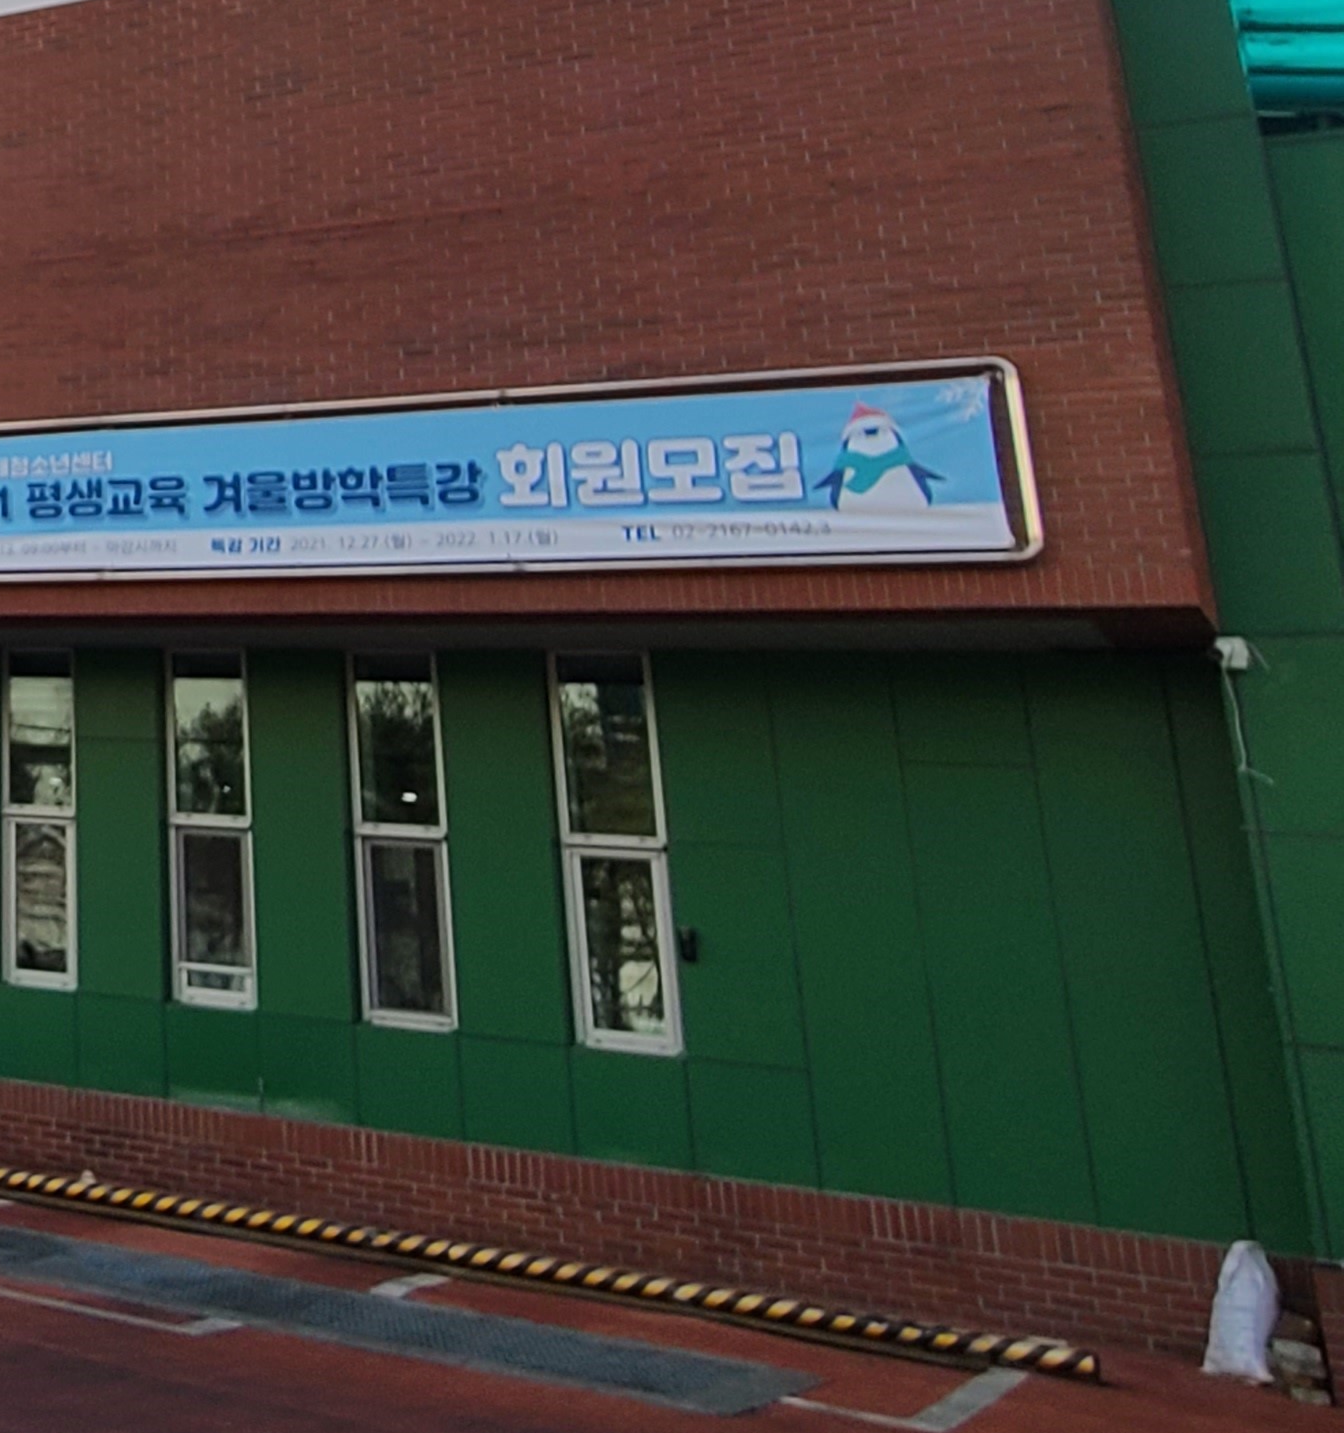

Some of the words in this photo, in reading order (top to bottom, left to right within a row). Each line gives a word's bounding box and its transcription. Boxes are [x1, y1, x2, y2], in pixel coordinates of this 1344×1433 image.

[25, 472, 189, 521] 평생교육
[203, 459, 484, 515] 겨울방학특강
[496, 432, 804, 508] 회원모집
[622, 523, 660, 543] TEL
[249, 535, 281, 553] 기간
